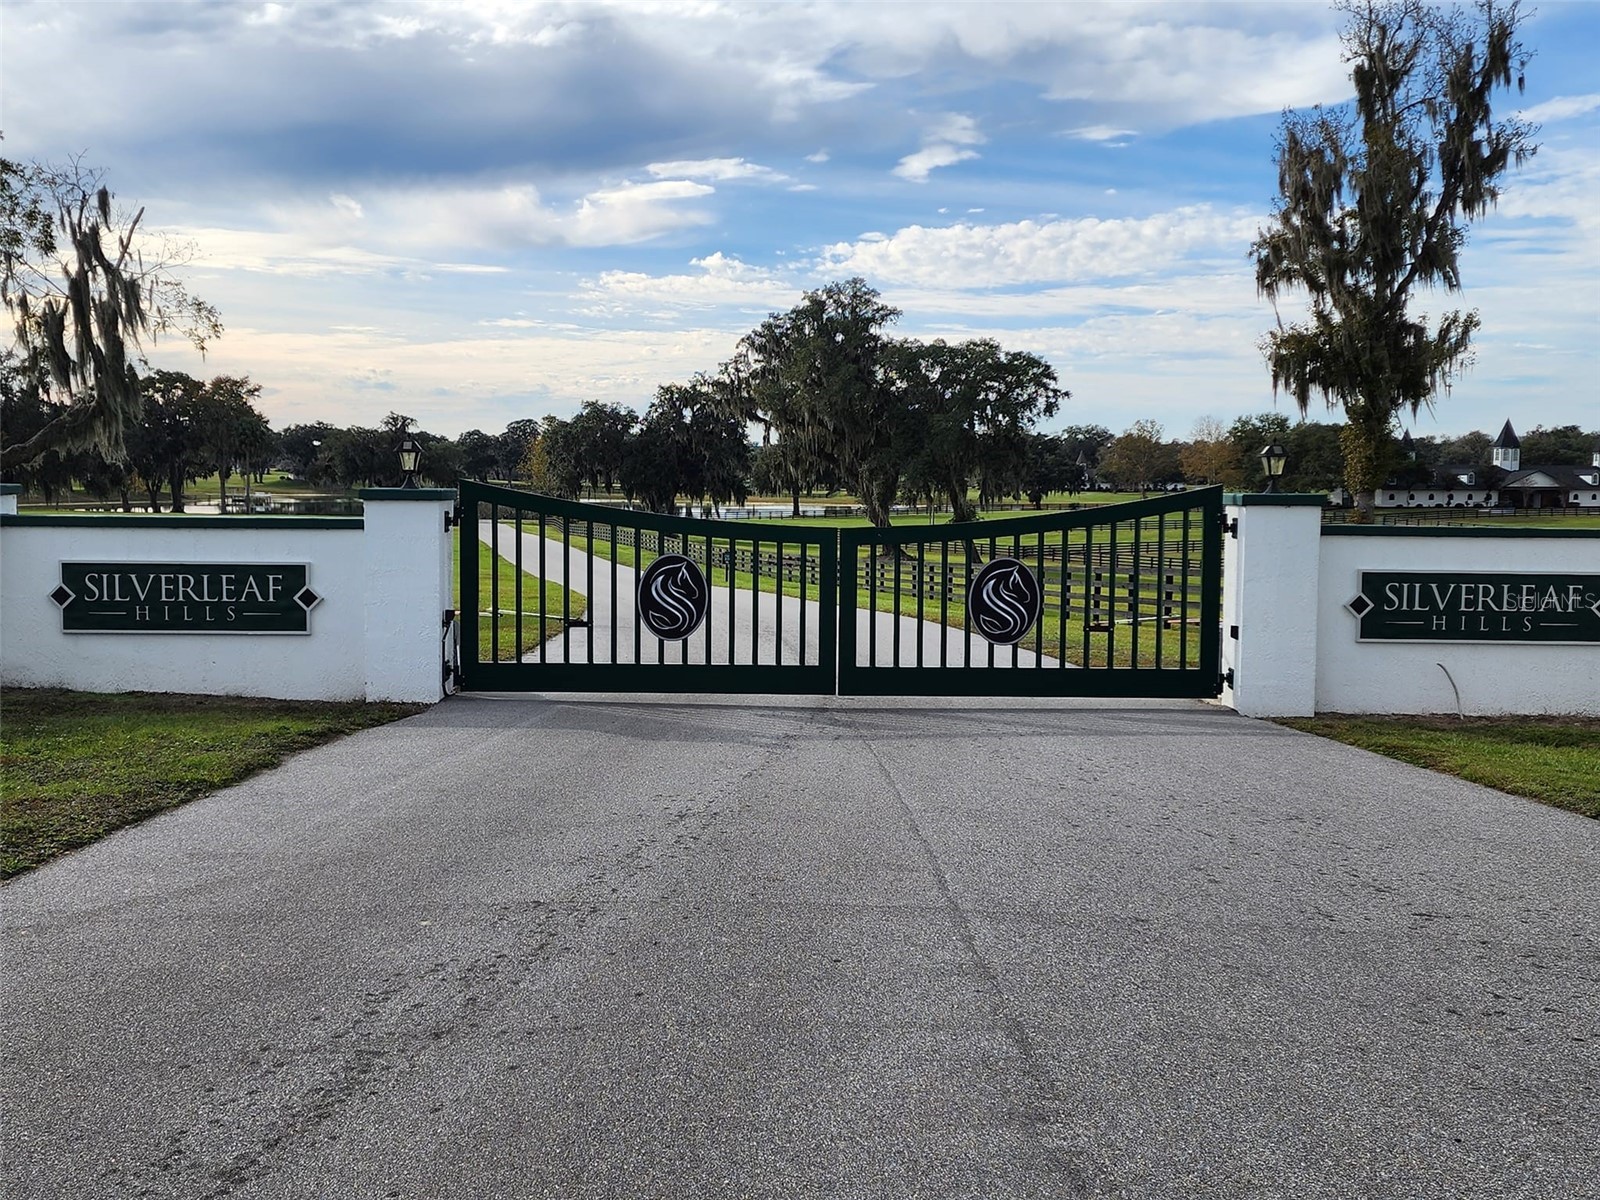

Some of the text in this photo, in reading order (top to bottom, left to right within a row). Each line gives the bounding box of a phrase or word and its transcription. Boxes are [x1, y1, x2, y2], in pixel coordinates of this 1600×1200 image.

[84, 573, 283, 602] SILVERLEAF
[1383, 582, 1584, 613] SILVERLEAF
[135, 606, 236, 621] HILLS
[1431, 615, 1532, 632] HILLS
